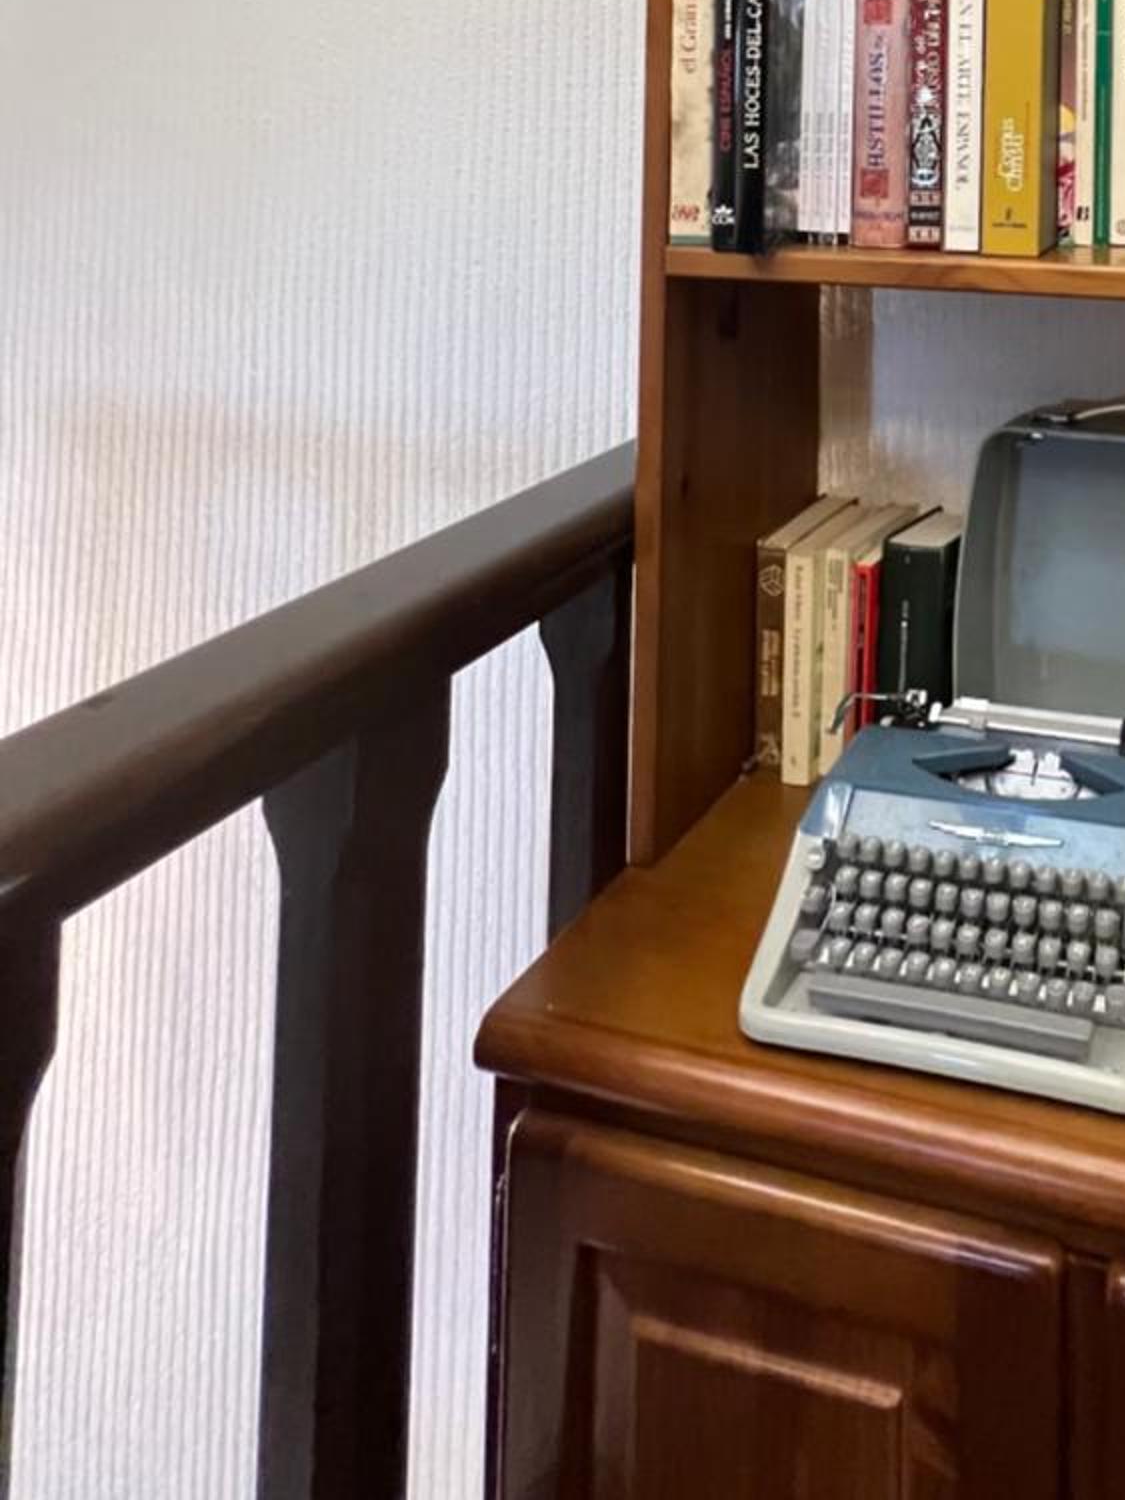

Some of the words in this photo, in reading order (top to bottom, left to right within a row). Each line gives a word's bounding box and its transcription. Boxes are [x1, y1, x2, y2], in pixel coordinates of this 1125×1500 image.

[680, 4, 700, 52] Gran
[745, 28, 763, 60] DEL
[958, 22, 974, 43] EL
[681, 58, 698, 74] el
[957, 53, 973, 106] ARTE
[743, 65, 762, 127] HOCES
[742, 131, 761, 169] LAS
[997, 118, 1015, 178] Corpus
[1006, 132, 1025, 191] Christi
